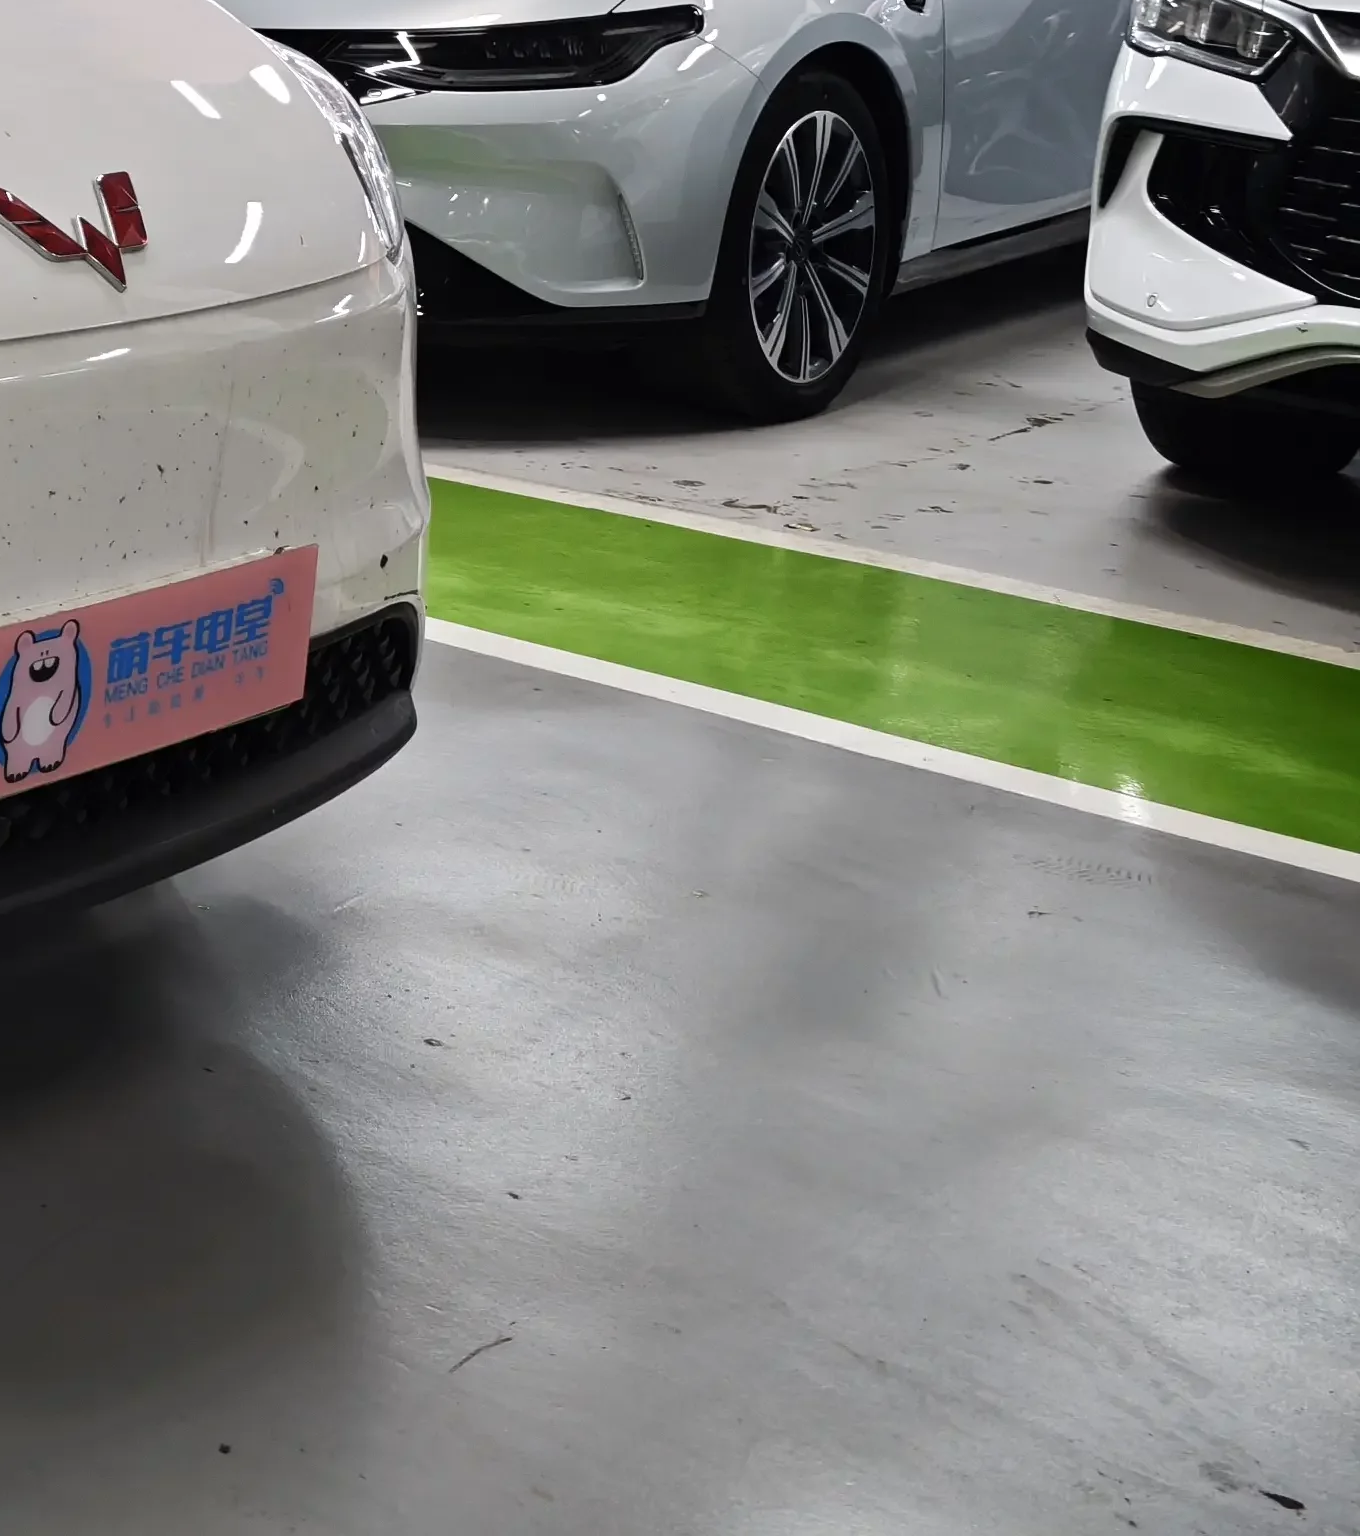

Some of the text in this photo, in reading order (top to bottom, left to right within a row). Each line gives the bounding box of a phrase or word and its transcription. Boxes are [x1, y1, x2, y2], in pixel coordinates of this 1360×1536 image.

[104, 640, 268, 706] MENG CHE DIAN TANG
[107, 594, 274, 684] 萌车电堂
